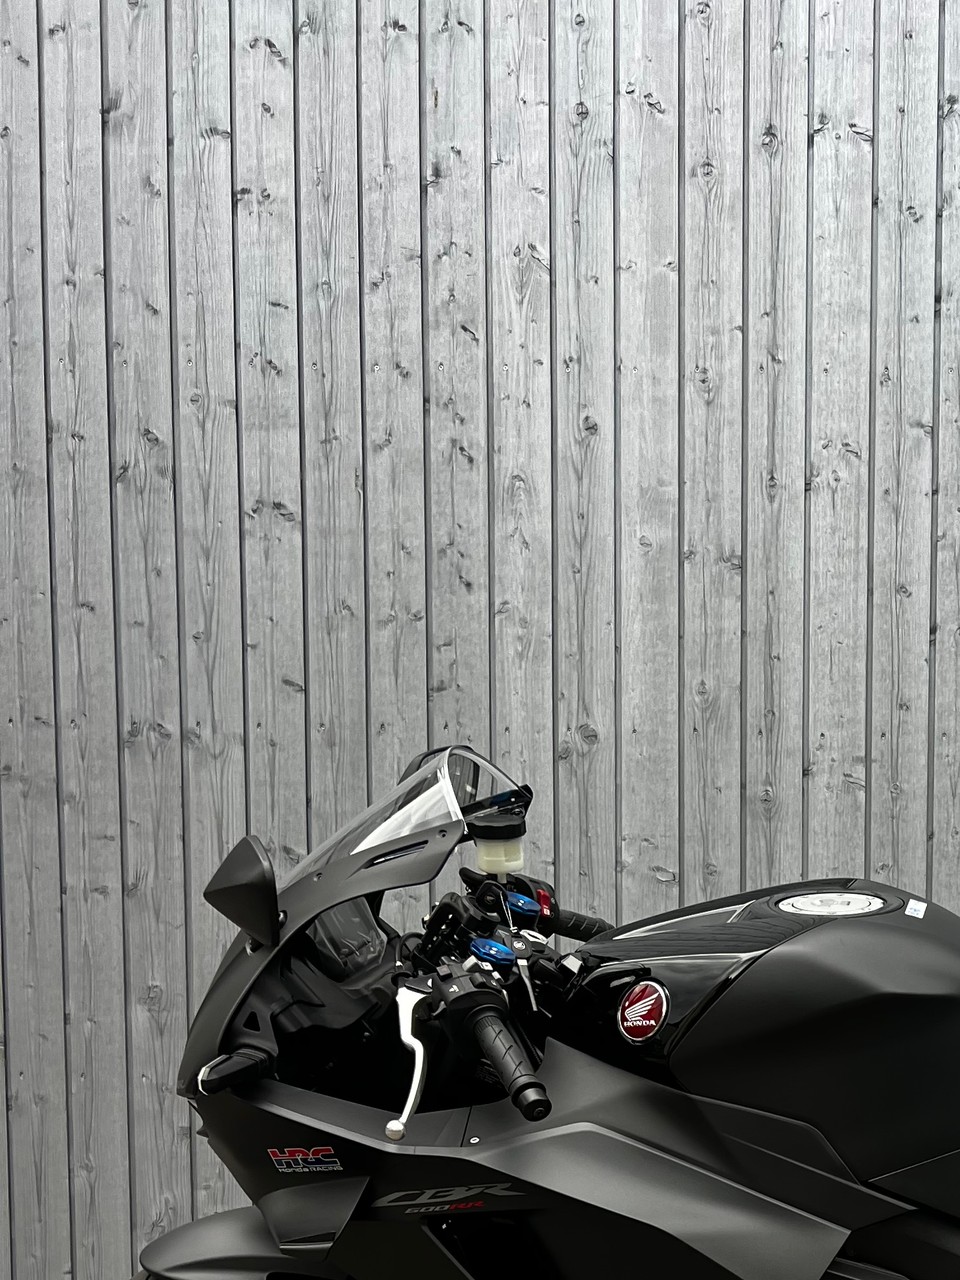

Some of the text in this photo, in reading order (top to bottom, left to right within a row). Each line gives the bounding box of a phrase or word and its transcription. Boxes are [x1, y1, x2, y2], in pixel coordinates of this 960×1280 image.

[267, 1147, 340, 1168] HRC
[371, 1183, 527, 1207] CBR
[405, 1200, 486, 1214] 600RR
